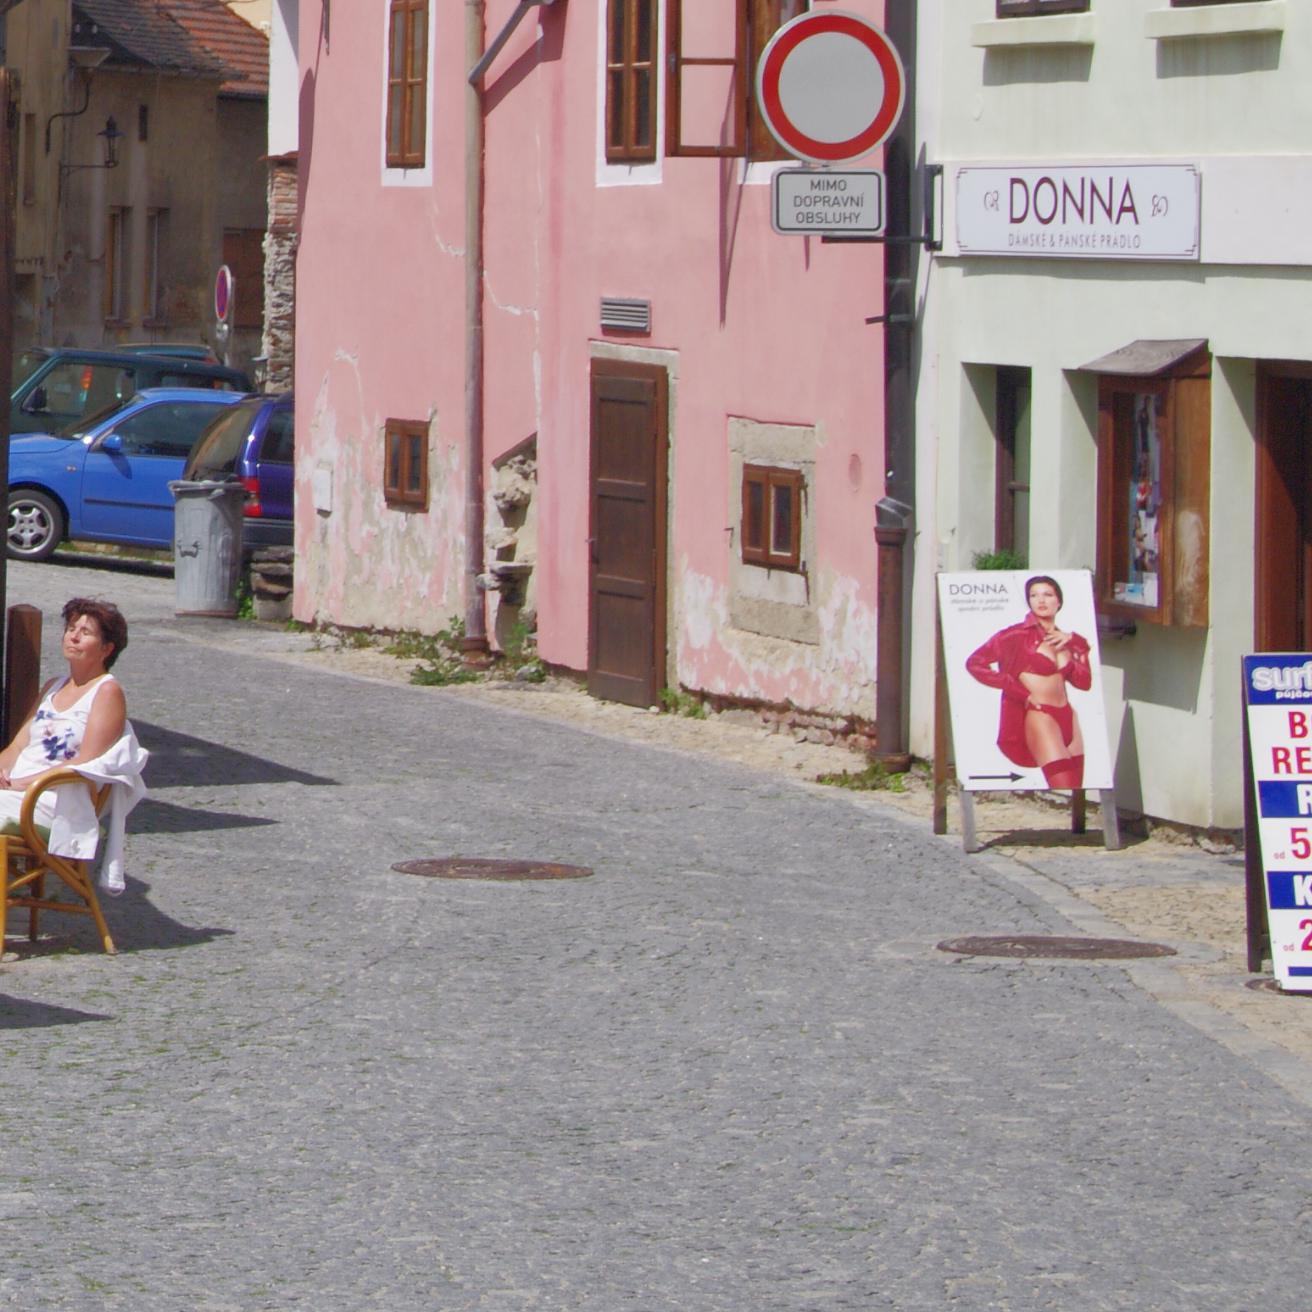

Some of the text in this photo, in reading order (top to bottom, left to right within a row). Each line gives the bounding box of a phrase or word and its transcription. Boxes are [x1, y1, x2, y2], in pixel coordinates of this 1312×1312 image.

[810, 179, 847, 191] MIMO
[793, 192, 864, 207] DOPRAVNÍ
[1009, 176, 1140, 225] DONNA
[796, 212, 861, 224] OBSLUHY
[949, 583, 1008, 595] DONNA
